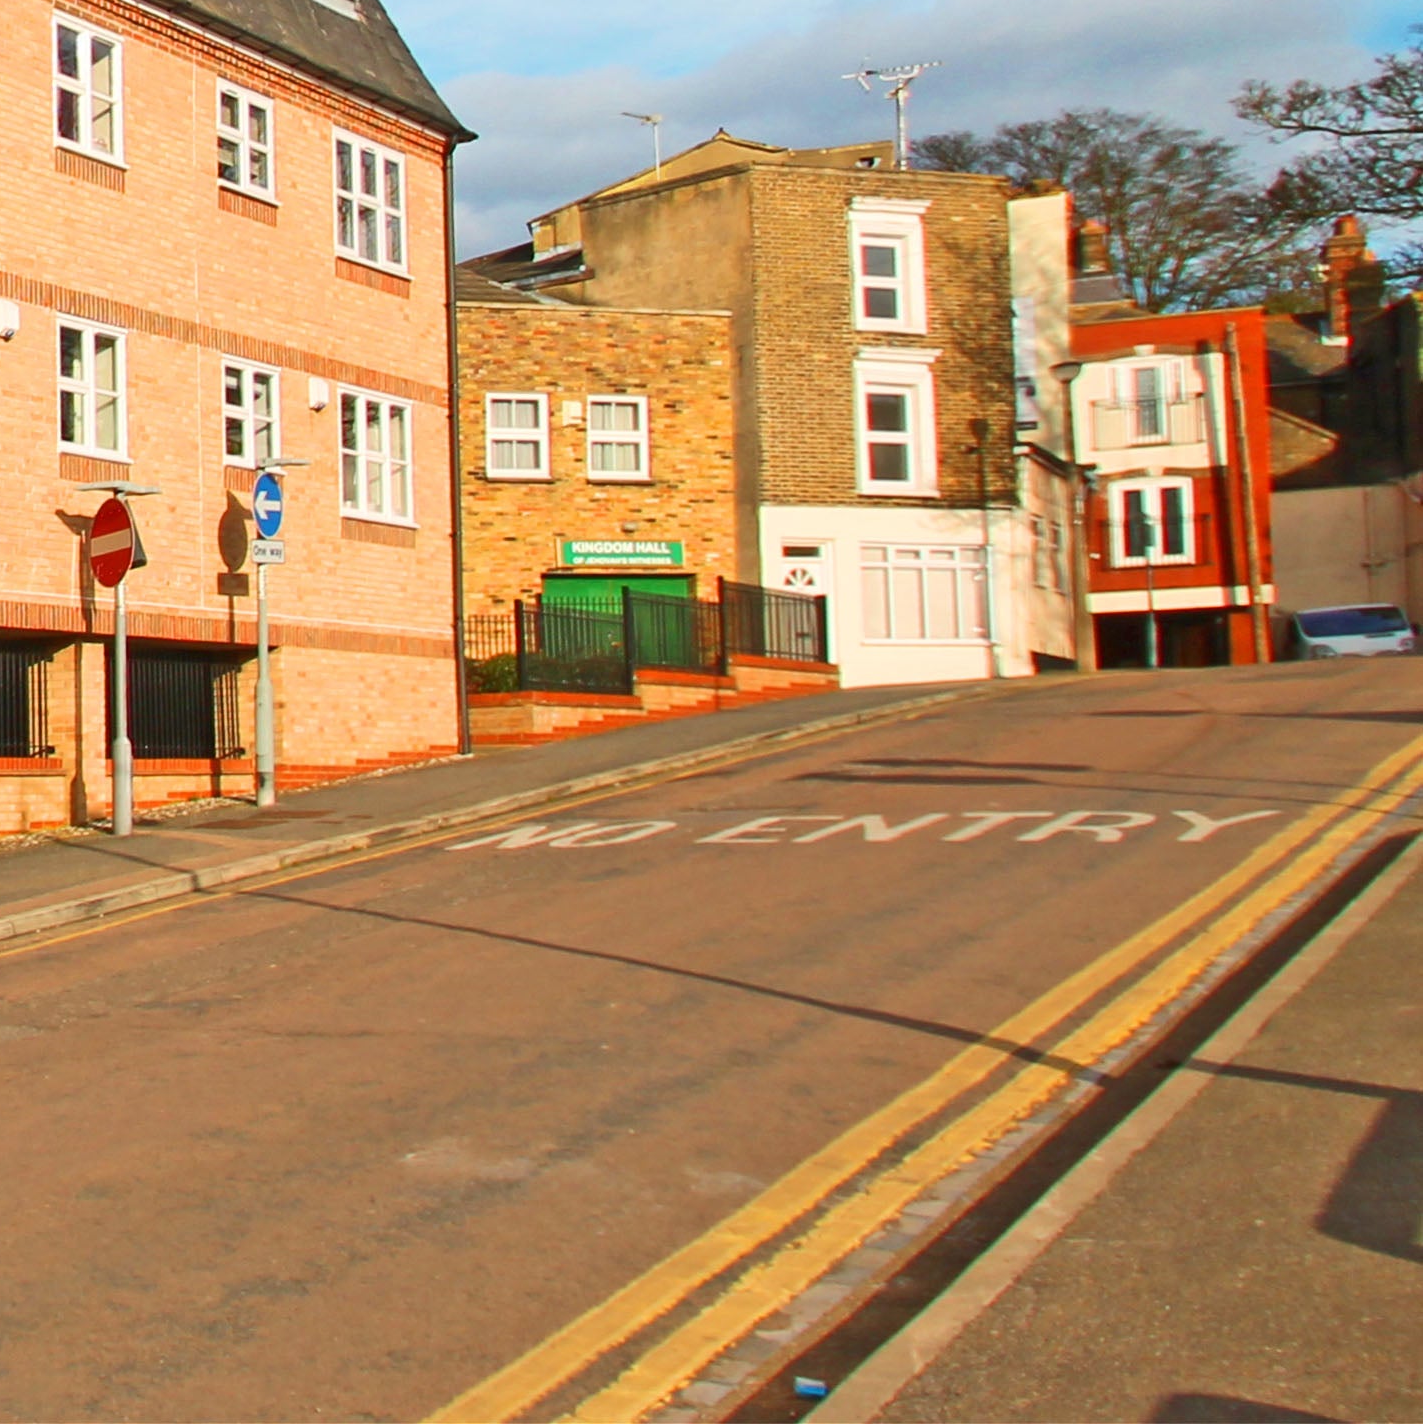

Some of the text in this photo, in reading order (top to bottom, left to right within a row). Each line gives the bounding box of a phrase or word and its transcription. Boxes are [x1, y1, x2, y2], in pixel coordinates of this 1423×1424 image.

[571, 541, 671, 554] KINGDOM HALL
[443, 809, 1284, 851] NO ENTRY
